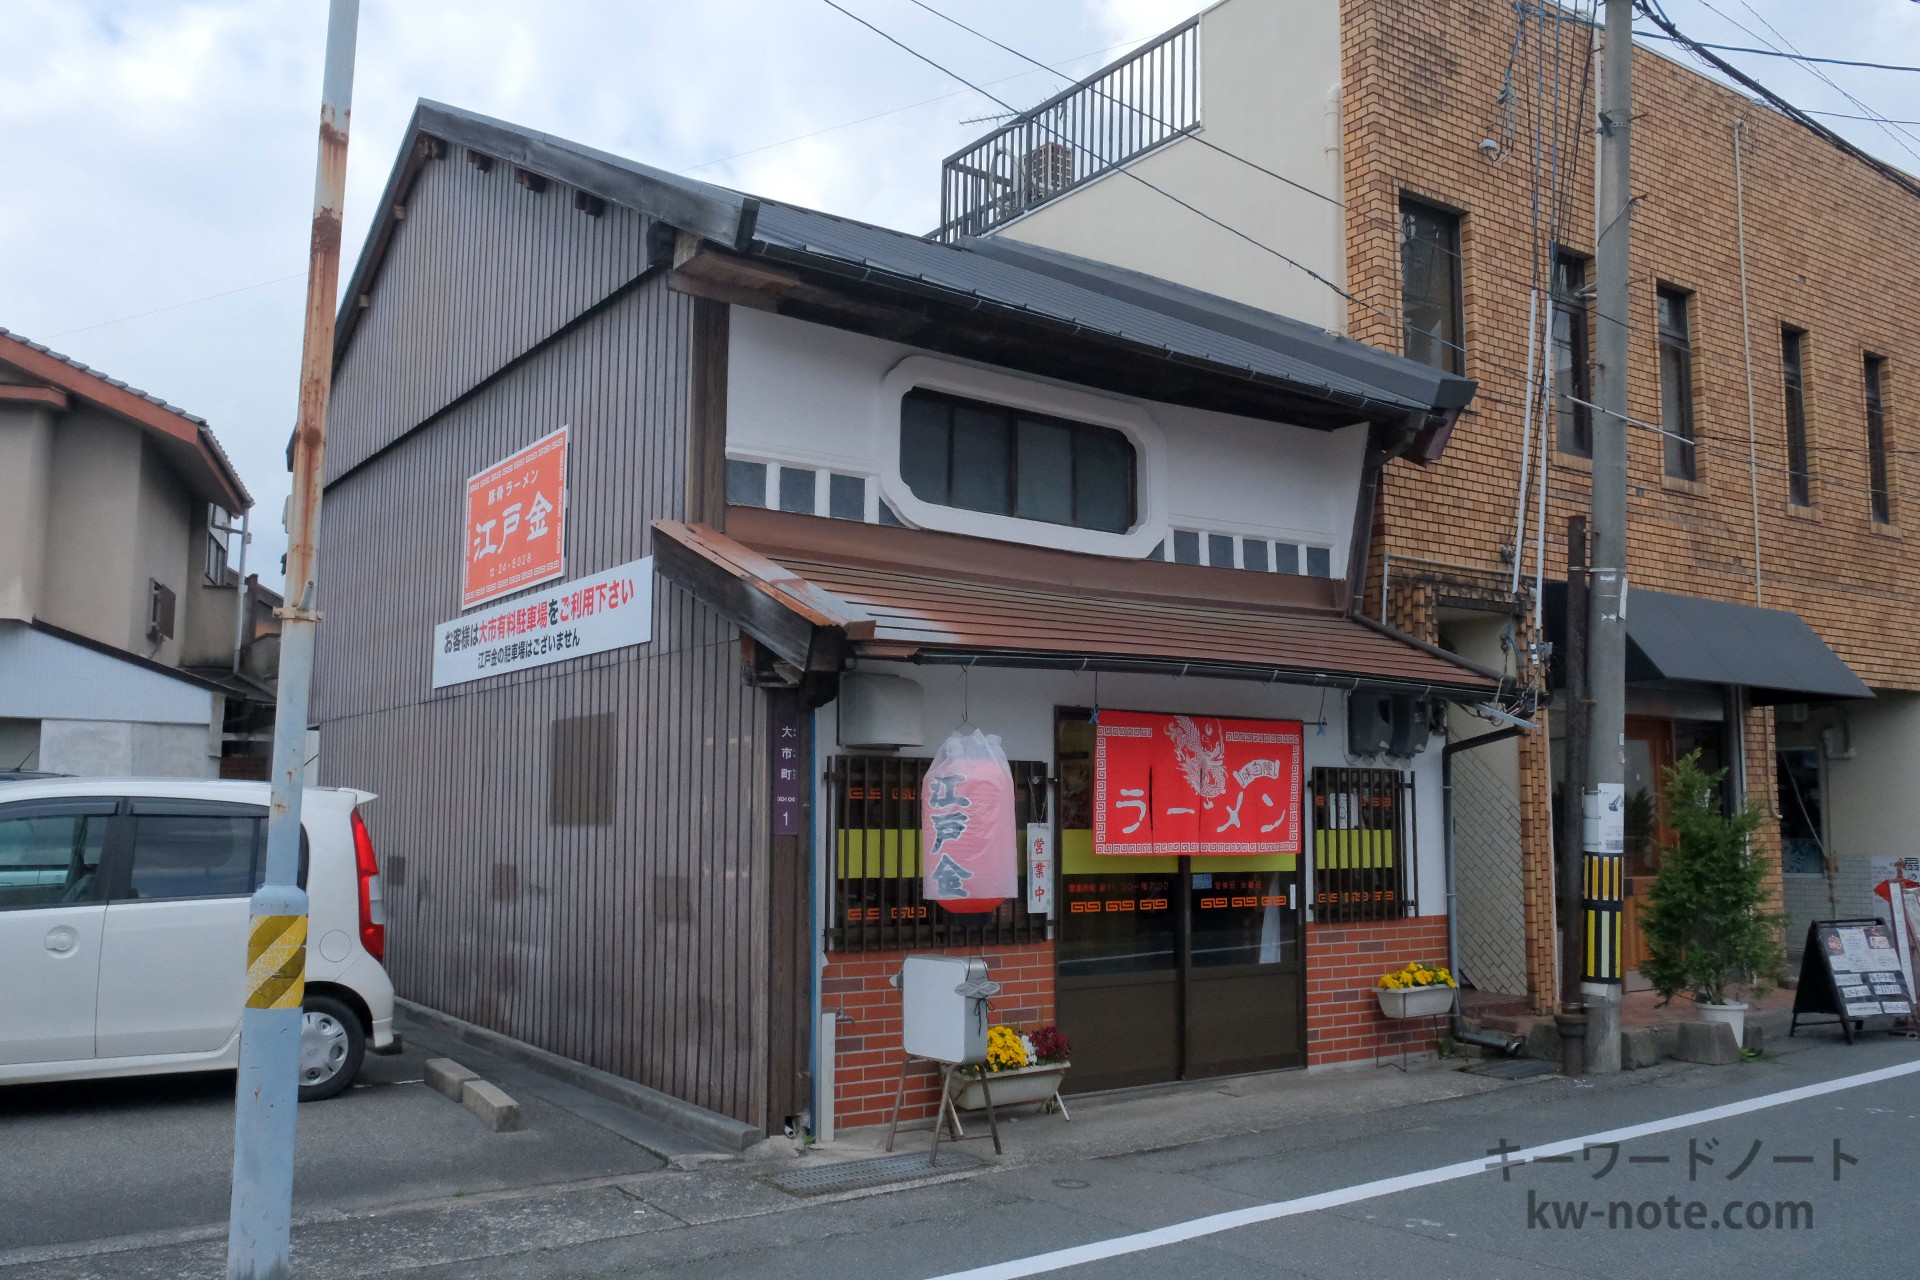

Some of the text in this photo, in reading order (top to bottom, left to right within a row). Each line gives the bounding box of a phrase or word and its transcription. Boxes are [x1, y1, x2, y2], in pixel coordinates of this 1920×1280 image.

[488, 469, 539, 505] 豚骨ラーメン
[474, 491, 553, 563] 江戸金
[444, 578, 635, 654] お客様は大市有料駐車場をご利用下さい
[477, 628, 581, 669] 江戸金の駐車場はございません
[780, 725, 793, 780] 大市町
[783, 811, 788, 827] 1
[929, 773, 974, 898] 江戸金
[1115, 788, 1286, 834] ラーメン
[1032, 837, 1046, 904] 営業中
